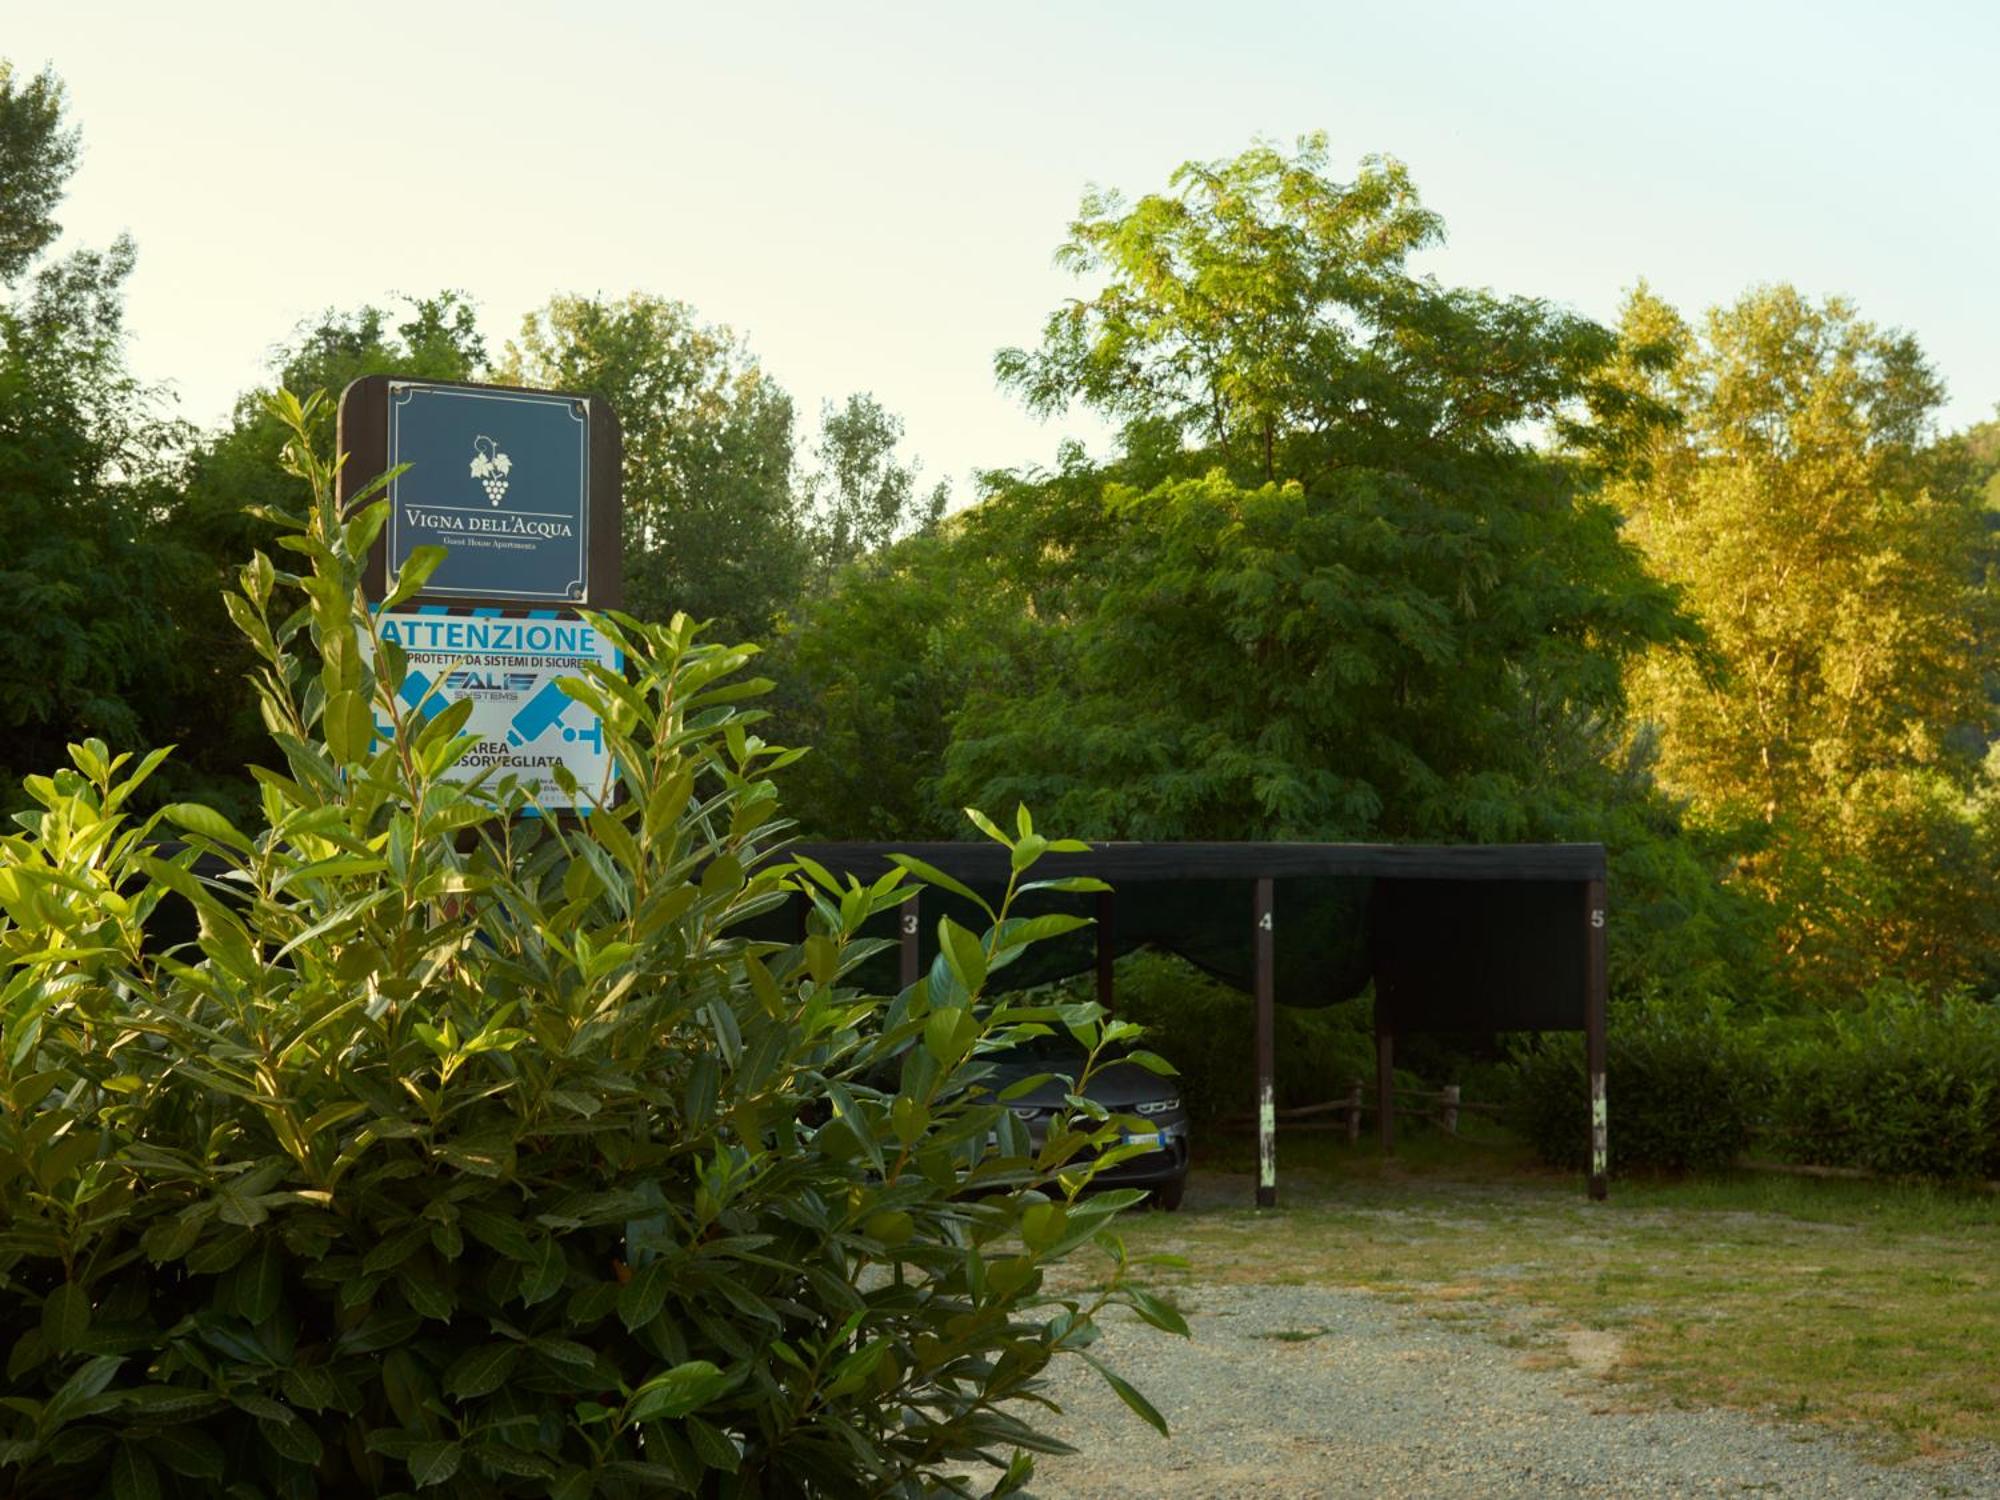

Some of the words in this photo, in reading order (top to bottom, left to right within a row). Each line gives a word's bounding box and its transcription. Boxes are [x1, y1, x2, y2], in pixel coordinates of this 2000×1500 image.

[405, 509, 465, 530] VIGNA
[443, 536, 465, 546] Guest
[467, 537, 492, 547] House
[493, 539, 537, 550] Apartments
[380, 620, 596, 652] ATTENZIONE
[466, 653, 481, 666] DA
[484, 655, 528, 668] SISTEMI
[530, 656, 543, 668] DI
[546, 656, 602, 669] SICURE
[468, 742, 509, 755] AREA
[453, 754, 564, 768] SORVEGLIATA
[904, 915, 918, 934] 3
[1259, 912, 1272, 931] 4
[1591, 909, 1604, 928] 5
